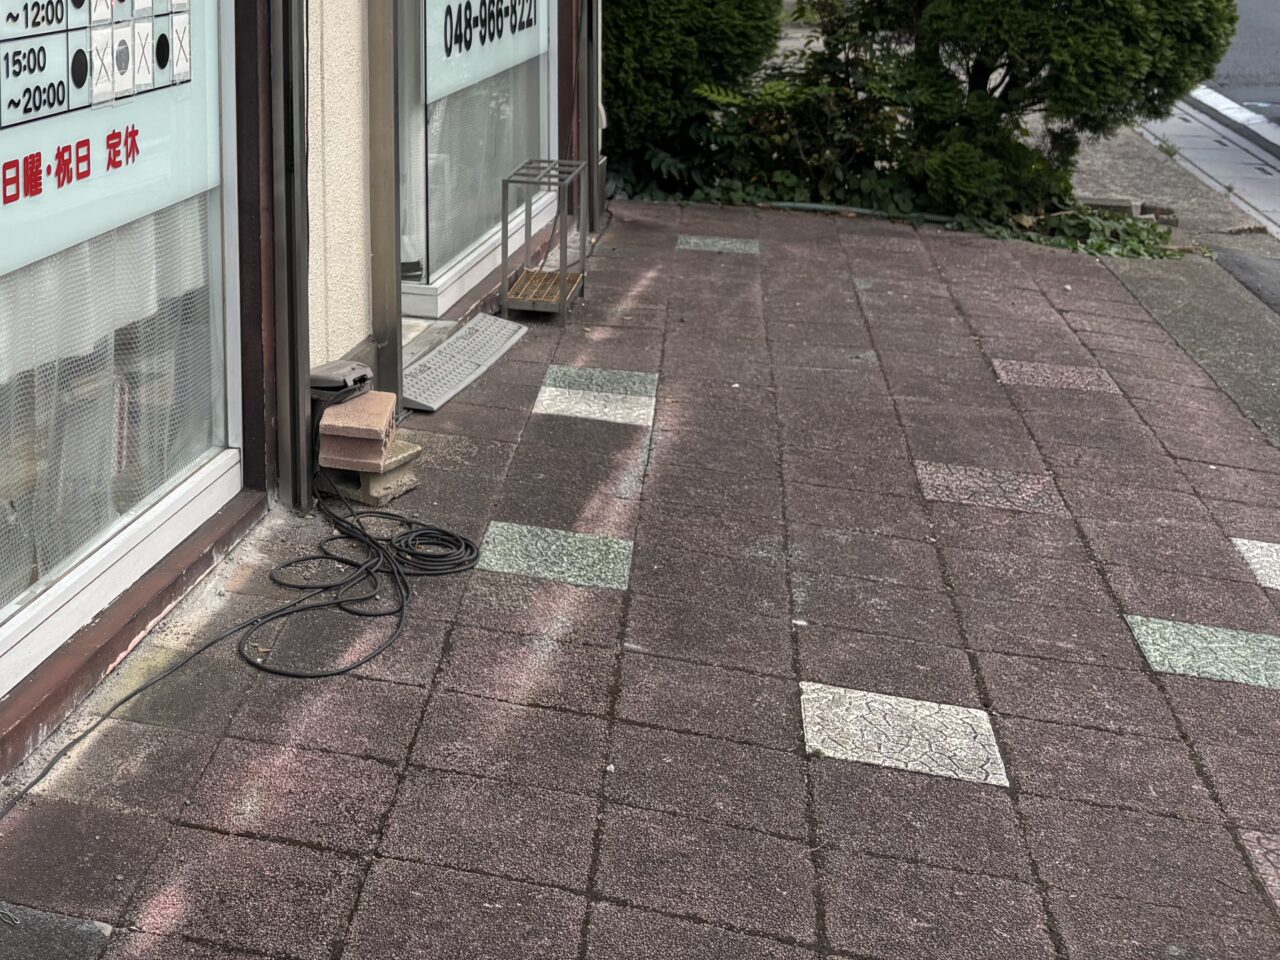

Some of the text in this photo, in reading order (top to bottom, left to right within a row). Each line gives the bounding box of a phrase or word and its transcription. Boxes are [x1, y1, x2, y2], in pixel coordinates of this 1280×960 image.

[3, 45, 47, 79] 15:00
[2, 123, 140, 206] 日曜・祝日 定休
